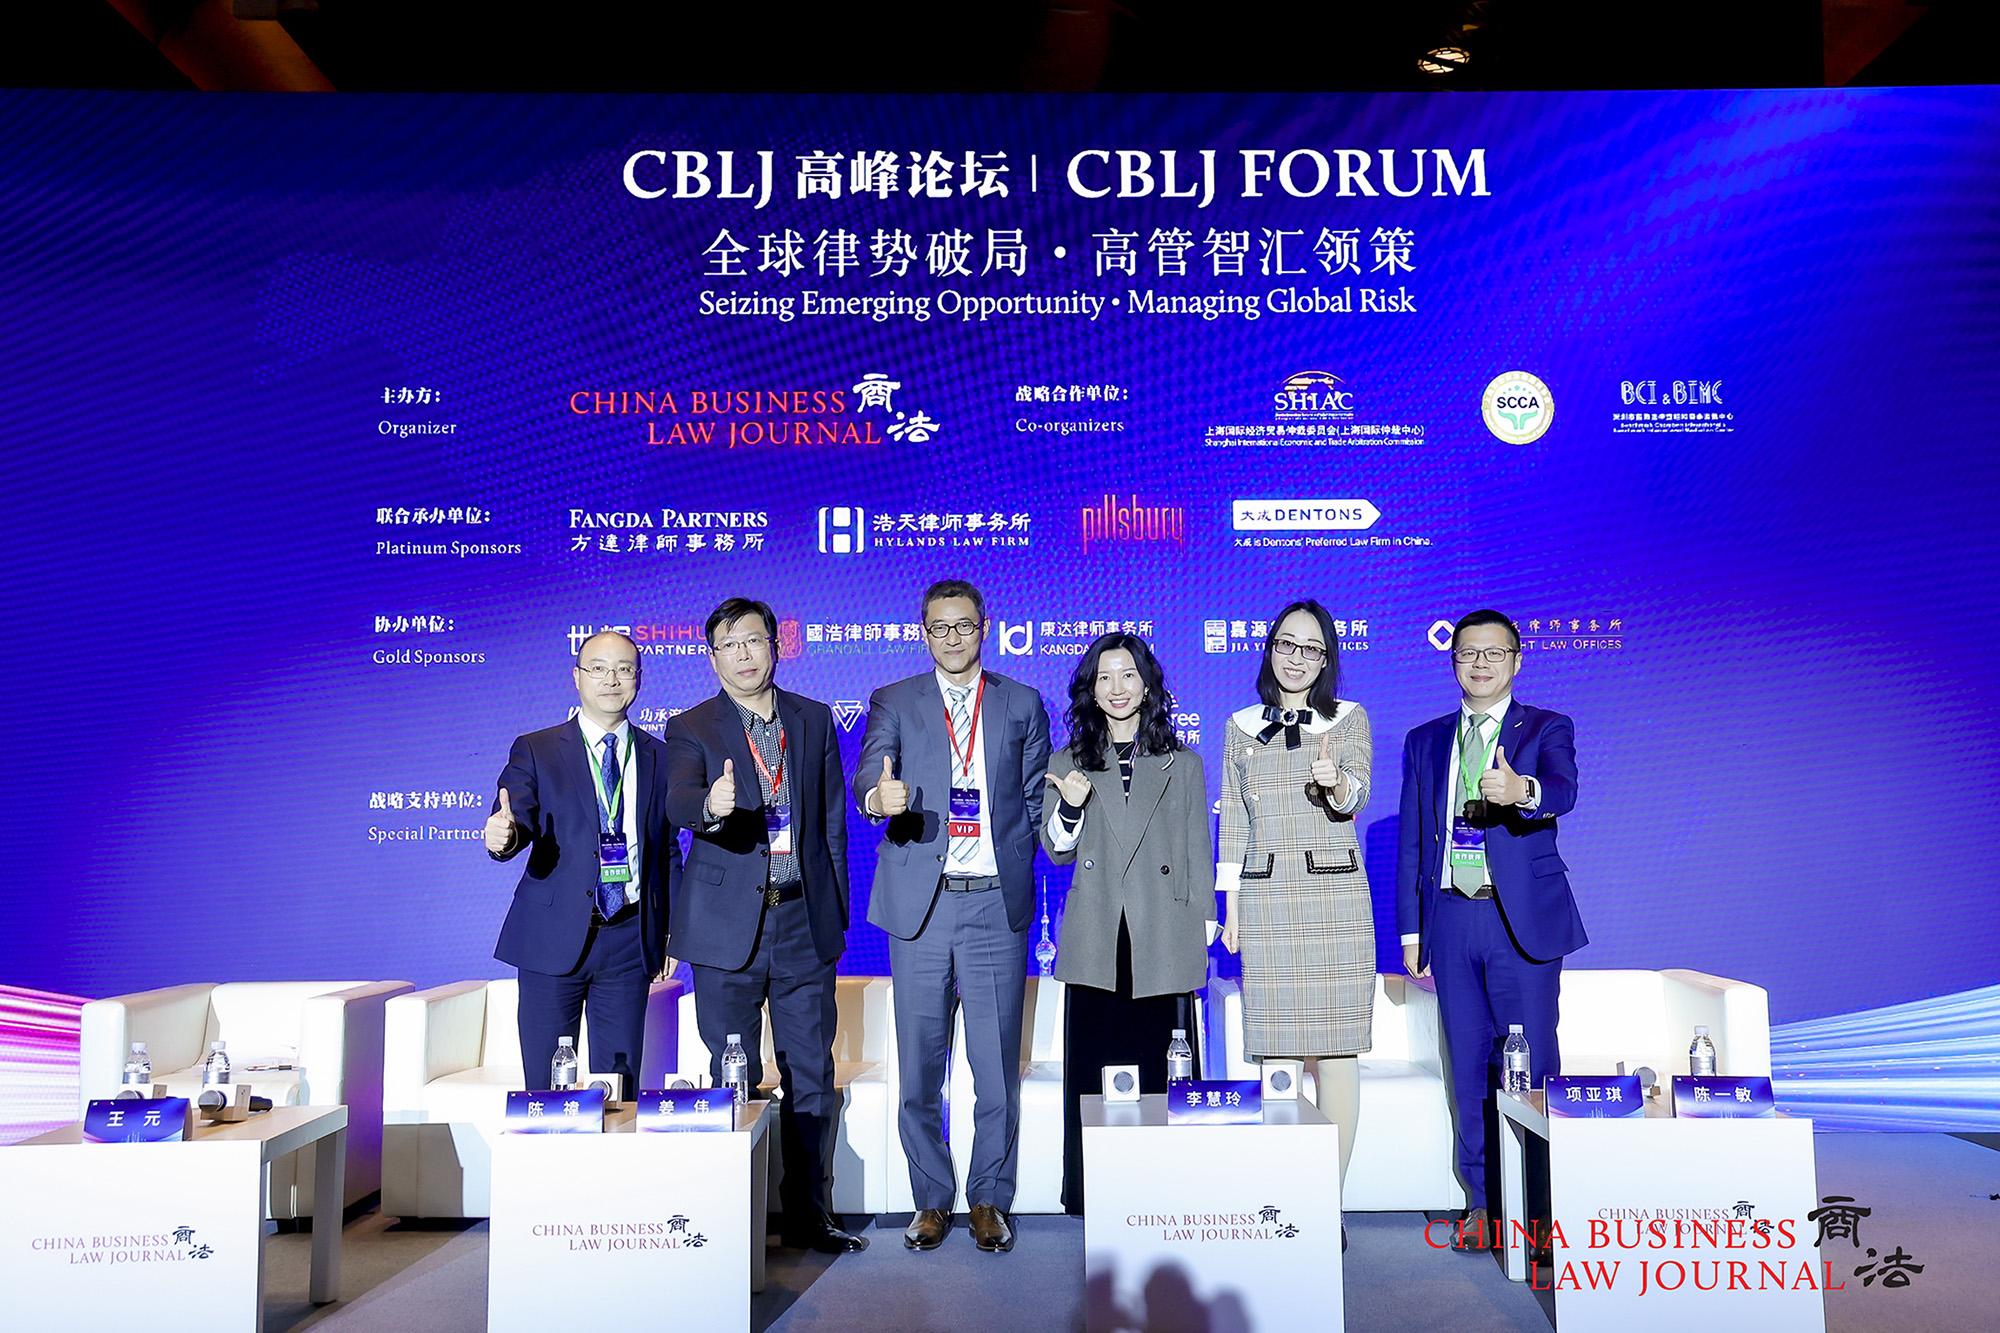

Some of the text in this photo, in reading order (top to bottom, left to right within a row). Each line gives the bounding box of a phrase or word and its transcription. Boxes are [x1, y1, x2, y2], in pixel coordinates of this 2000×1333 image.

[623, 148, 1492, 209] CBLJ 高峰论坛 CBLJ FORUM
[701, 226, 1417, 278] 全球律势破局 高管智汇领策
[699, 287, 1418, 321] Seizing Emerging Opportunity Managing Global Risk
[1015, 384, 1129, 403] 战略合作单位：
[1273, 392, 1354, 411] SHIAC
[1620, 380, 1658, 406] BCI
[1672, 380, 1724, 405] BIMC
[569, 391, 847, 415] CHINA BUSINESS
[852, 372, 941, 443] 商法
[1496, 396, 1540, 409] SCCA
[378, 420, 458, 439] Organizer
[647, 421, 883, 449] LAW JOURNAL
[1015, 418, 1125, 436] Co-organizers
[376, 506, 491, 525] 联合承办单位：
[569, 508, 769, 529] FANGDA PARTNERS
[872, 512, 1032, 533] 浩天律师事务所
[1081, 494, 1184, 555] pillsbury
[1240, 508, 1364, 523] 大成 DENTONS
[375, 540, 522, 559] Platinum Sponsors
[570, 533, 766, 553] 方達律師事務所
[874, 536, 1030, 548] HYLANDS LAW FIRM
[1305, 537, 1348, 547] Preferred
[1349, 537, 1369, 547] Law
[1370, 537, 1391, 547] Firm
[374, 615, 455, 633] 协办单位：
[635, 625, 707, 641] SHIHU
[806, 622, 926, 643] 國浩律師事務
[1039, 620, 1153, 638] 康达律师事务所
[638, 644, 711, 656] PARTNER
[907, 643, 930, 655] FIR
[1039, 644, 1091, 655] KANGDA
[1230, 641, 1250, 653] JIA
[1541, 639, 1568, 650] LAW
[1572, 638, 1622, 650] OFFICES
[372, 648, 486, 668] Gold Sponsors
[638, 723, 666, 732] WINT
[1170, 712, 1201, 727] ree
[368, 790, 483, 810] 战略支持单位：
[367, 825, 486, 845] Special Partner
[956, 825, 974, 834] VIP
[1186, 1090, 1242, 1108] 李慧玲
[1564, 1086, 1623, 1103] 项亚琪
[1693, 1086, 1753, 1103] 陈一敏
[658, 1098, 710, 1117] 姜伟
[106, 1110, 162, 1128] 王元
[1127, 1213, 1257, 1228] CHINA BUSINESS
[1597, 1208, 1731, 1220] CHINA BUSINESS
[532, 1222, 664, 1237] CHINA BUSINESS
[1162, 1227, 1274, 1243] LAW JOURNAL
[31, 1234, 170, 1250] CHINA BUSINESS
[569, 1236, 682, 1253] LAW JOURNAL
[69, 1248, 187, 1266] LAW JOURNAL
